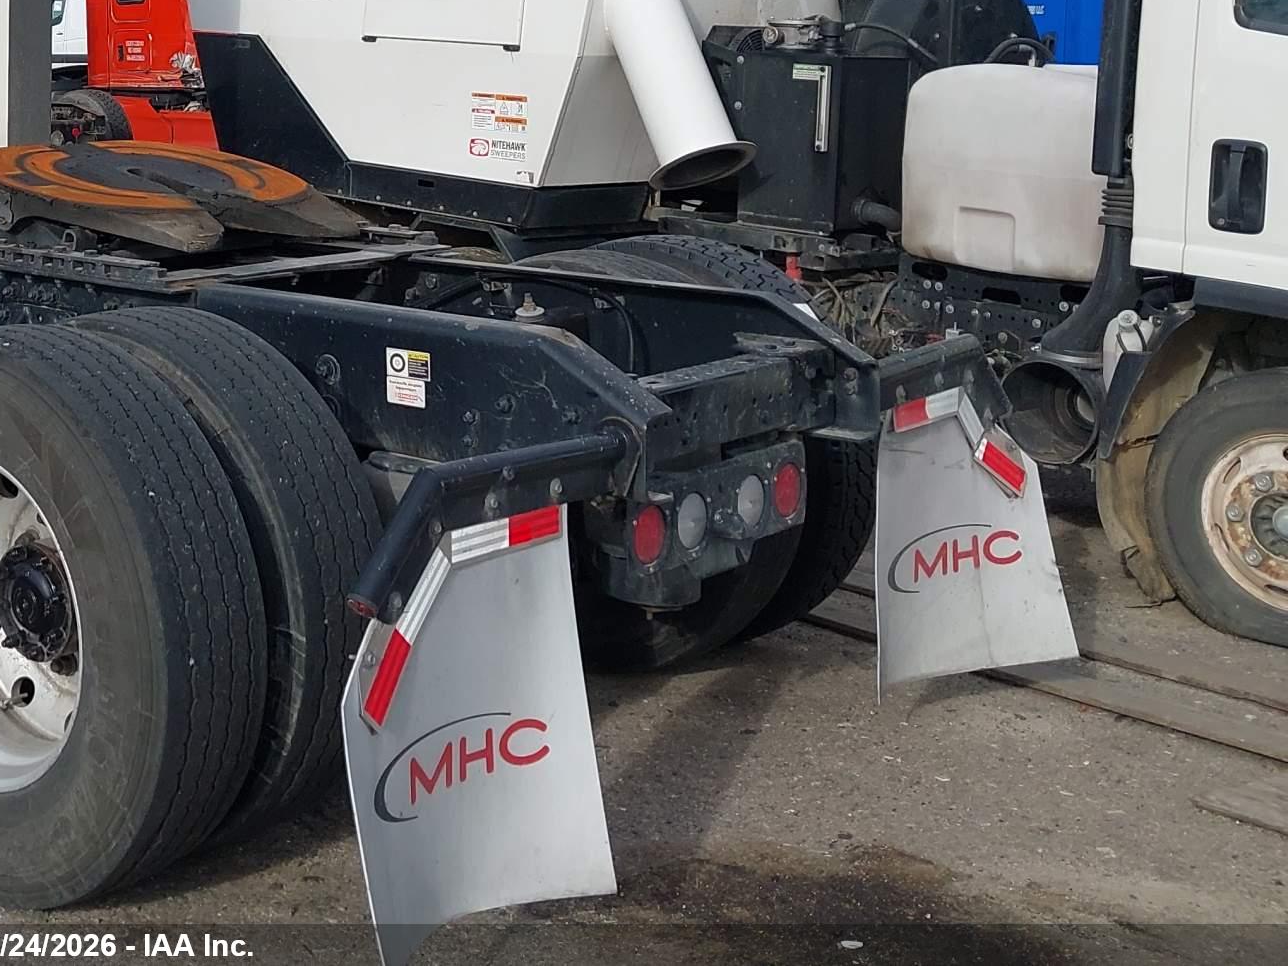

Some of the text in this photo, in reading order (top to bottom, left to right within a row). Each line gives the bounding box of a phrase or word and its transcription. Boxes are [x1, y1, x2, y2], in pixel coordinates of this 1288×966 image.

[490, 149, 526, 160] SWEEPERS
[491, 139, 526, 152] NITEHAWK
[912, 529, 1023, 583] MHC
[409, 718, 551, 806] MHC
